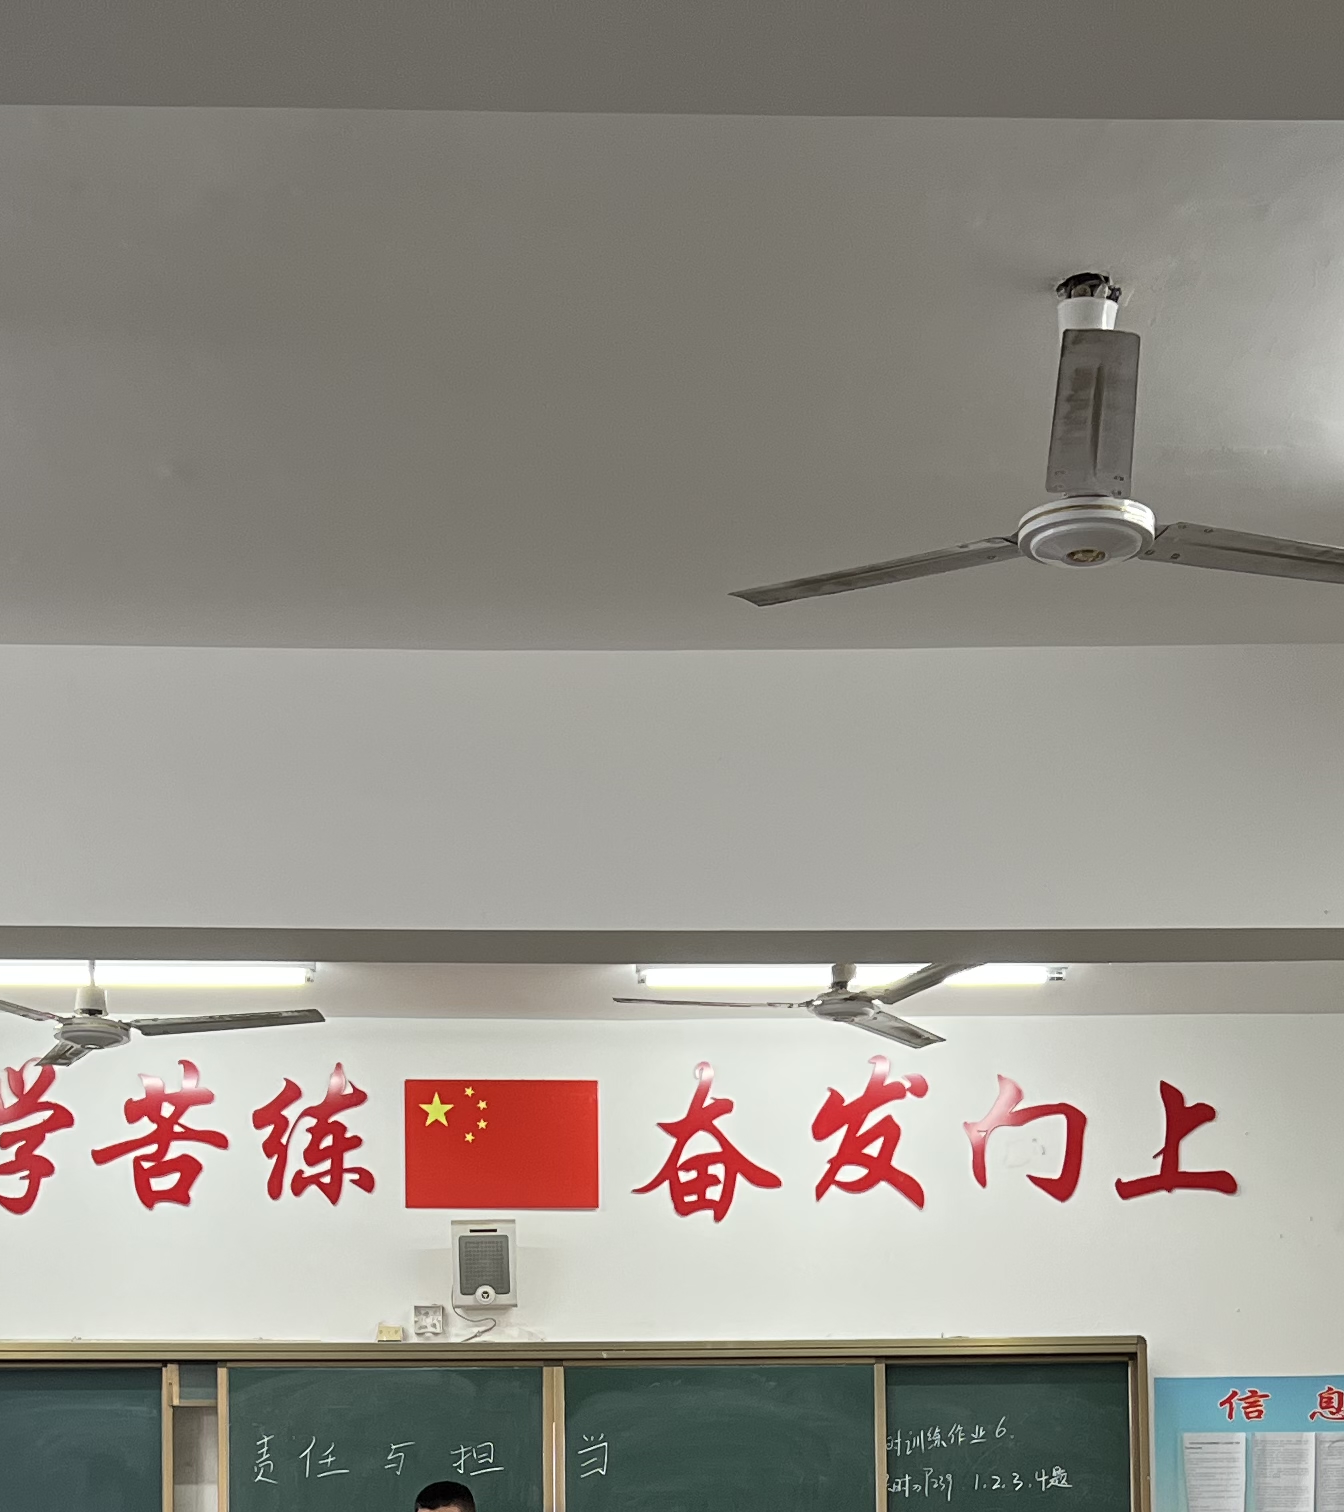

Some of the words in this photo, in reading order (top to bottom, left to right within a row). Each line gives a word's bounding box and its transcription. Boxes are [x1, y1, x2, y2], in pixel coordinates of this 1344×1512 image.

[253, 1433, 609, 1484] 责任与担当
